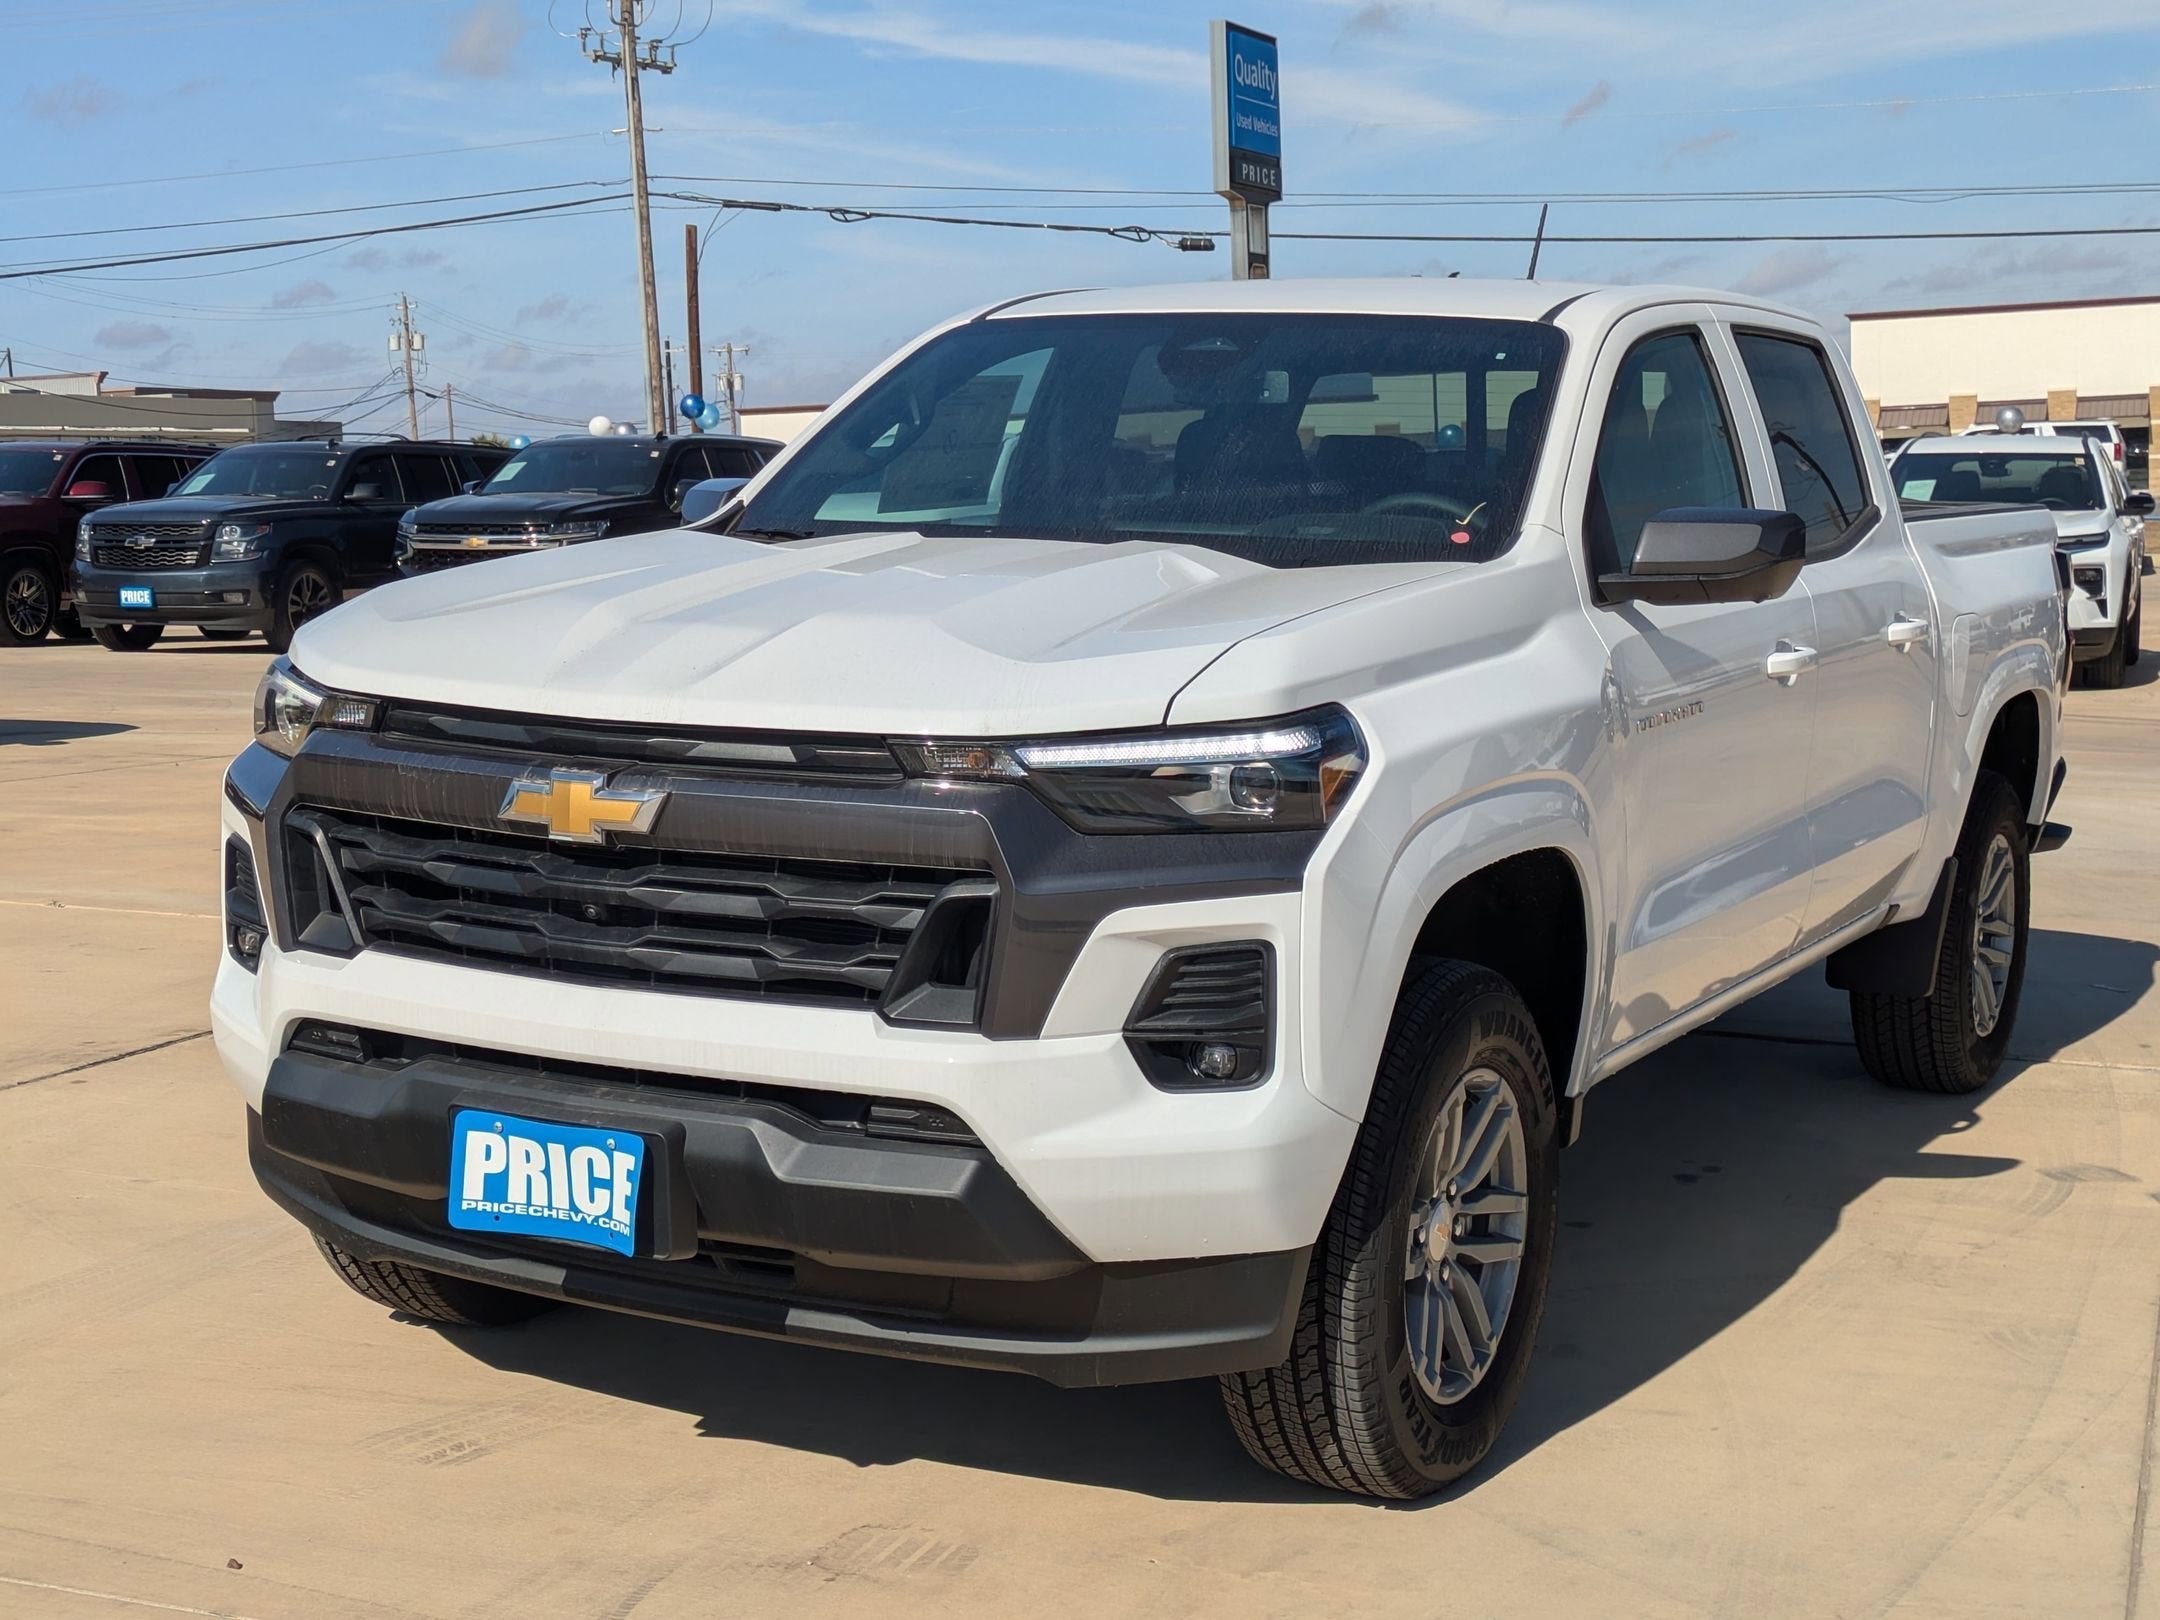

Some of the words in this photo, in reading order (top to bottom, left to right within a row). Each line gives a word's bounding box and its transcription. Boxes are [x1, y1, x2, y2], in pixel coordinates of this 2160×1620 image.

[1234, 54, 1277, 100] Quality
[1236, 112, 1252, 130] Used
[1253, 117, 1278, 137] Vehicles
[1242, 163, 1276, 186] PRICE
[121, 590, 150, 603] PRICE
[462, 1130, 635, 1225] PRICE
[461, 1200, 630, 1237] PRICECHEVY.COM
